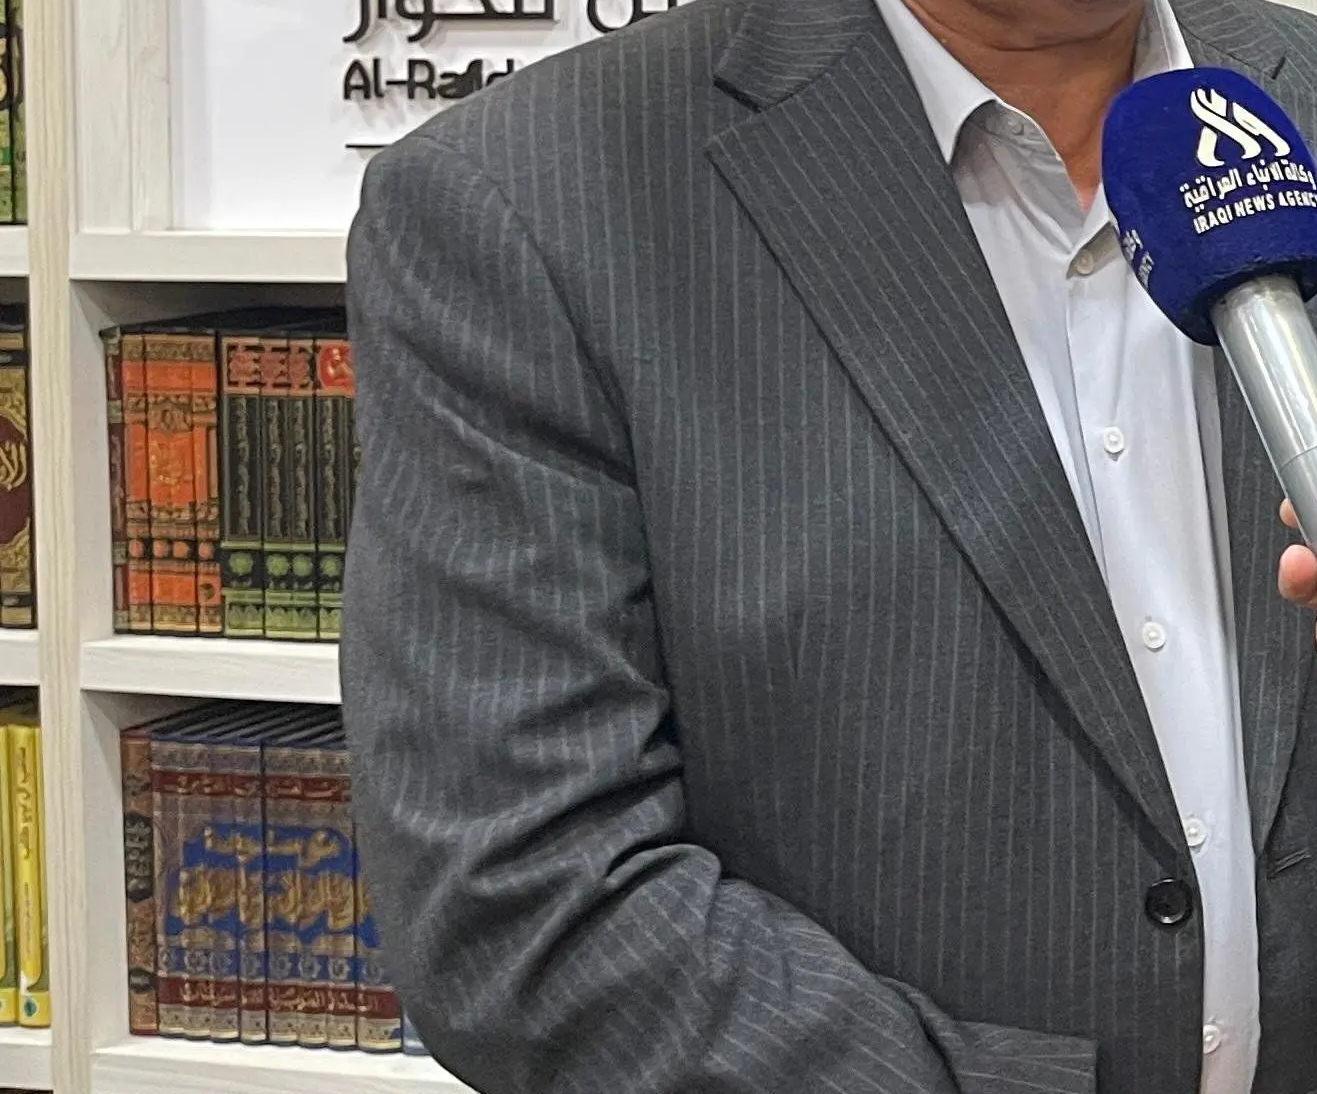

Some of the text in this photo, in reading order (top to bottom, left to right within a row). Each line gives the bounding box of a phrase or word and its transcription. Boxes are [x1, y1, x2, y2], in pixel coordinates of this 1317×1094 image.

[1179, 168, 1243, 213] العراقية
[1280, 159, 1317, 191] وكالة
[1193, 205, 1234, 234] IRAQI
[1234, 193, 1275, 218] NEWS
